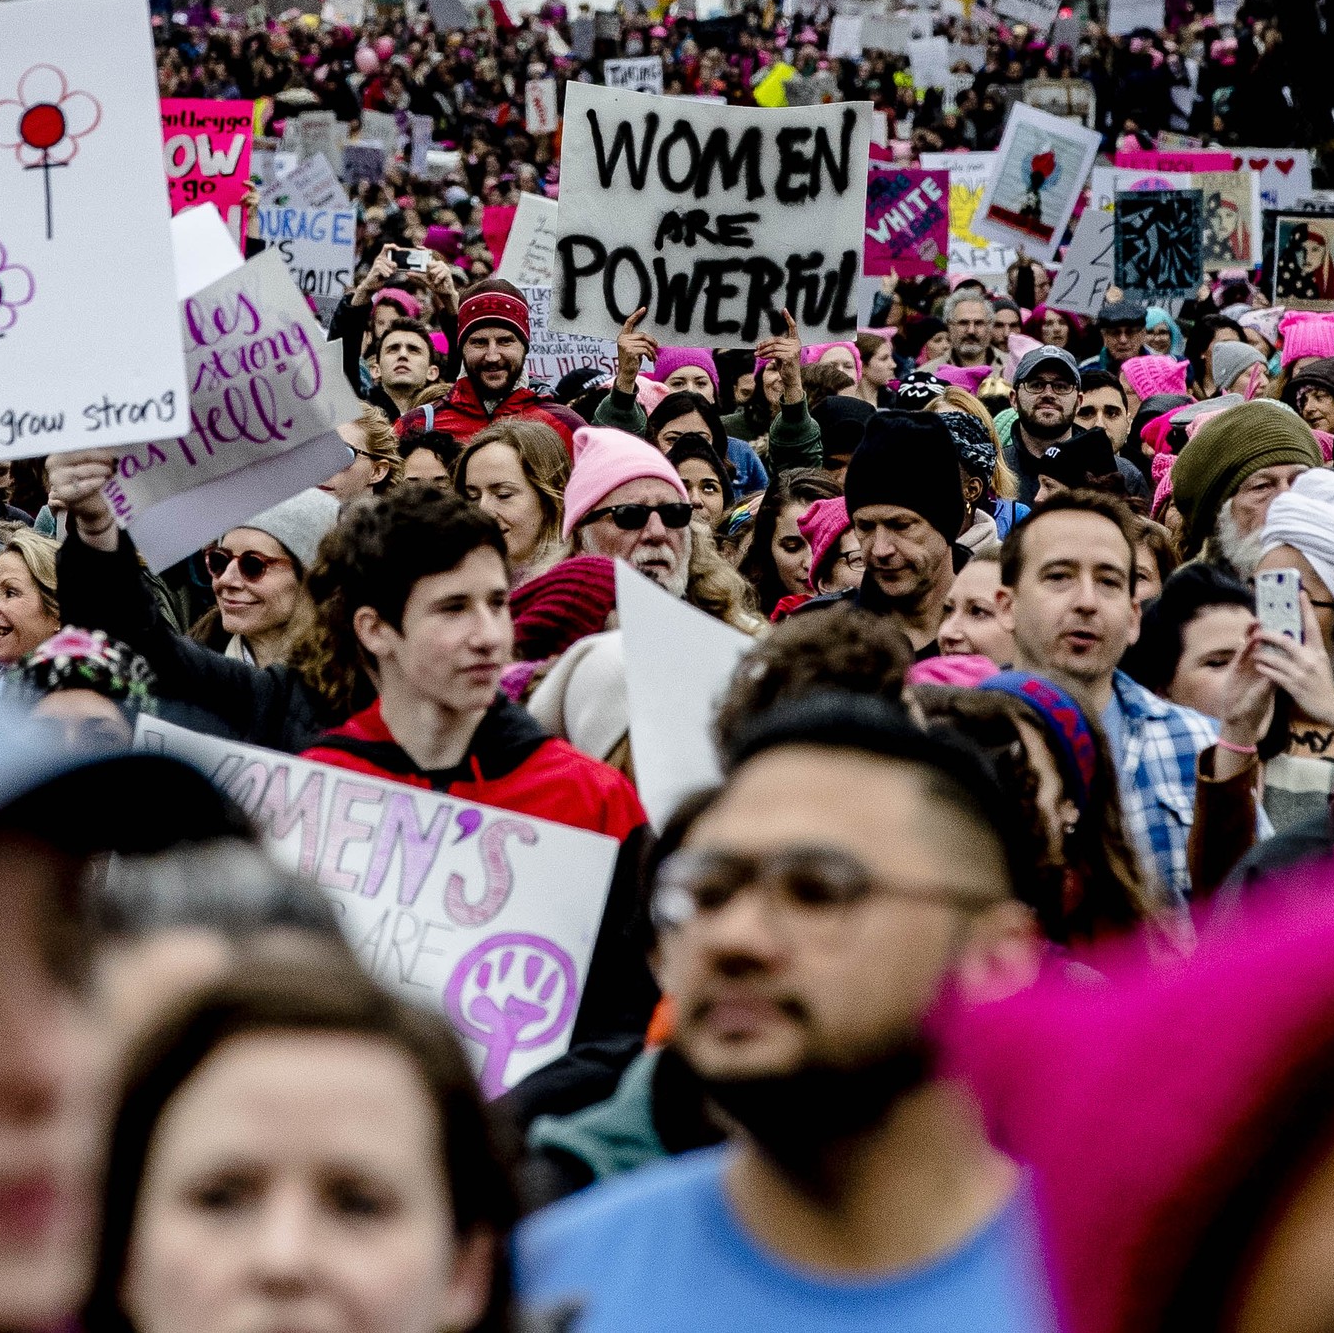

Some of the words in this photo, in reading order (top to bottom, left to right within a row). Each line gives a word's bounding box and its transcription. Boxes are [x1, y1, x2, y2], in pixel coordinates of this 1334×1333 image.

[585, 107, 858, 204] WOMEN
[654, 207, 761, 251] ARE
[865, 176, 943, 244] WHITE
[557, 233, 859, 342] POWERFUL
[1055, 269, 1081, 306] 2
[191, 321, 322, 401] strong
[0, 407, 65, 447] grow
[83, 389, 176, 433] strong
